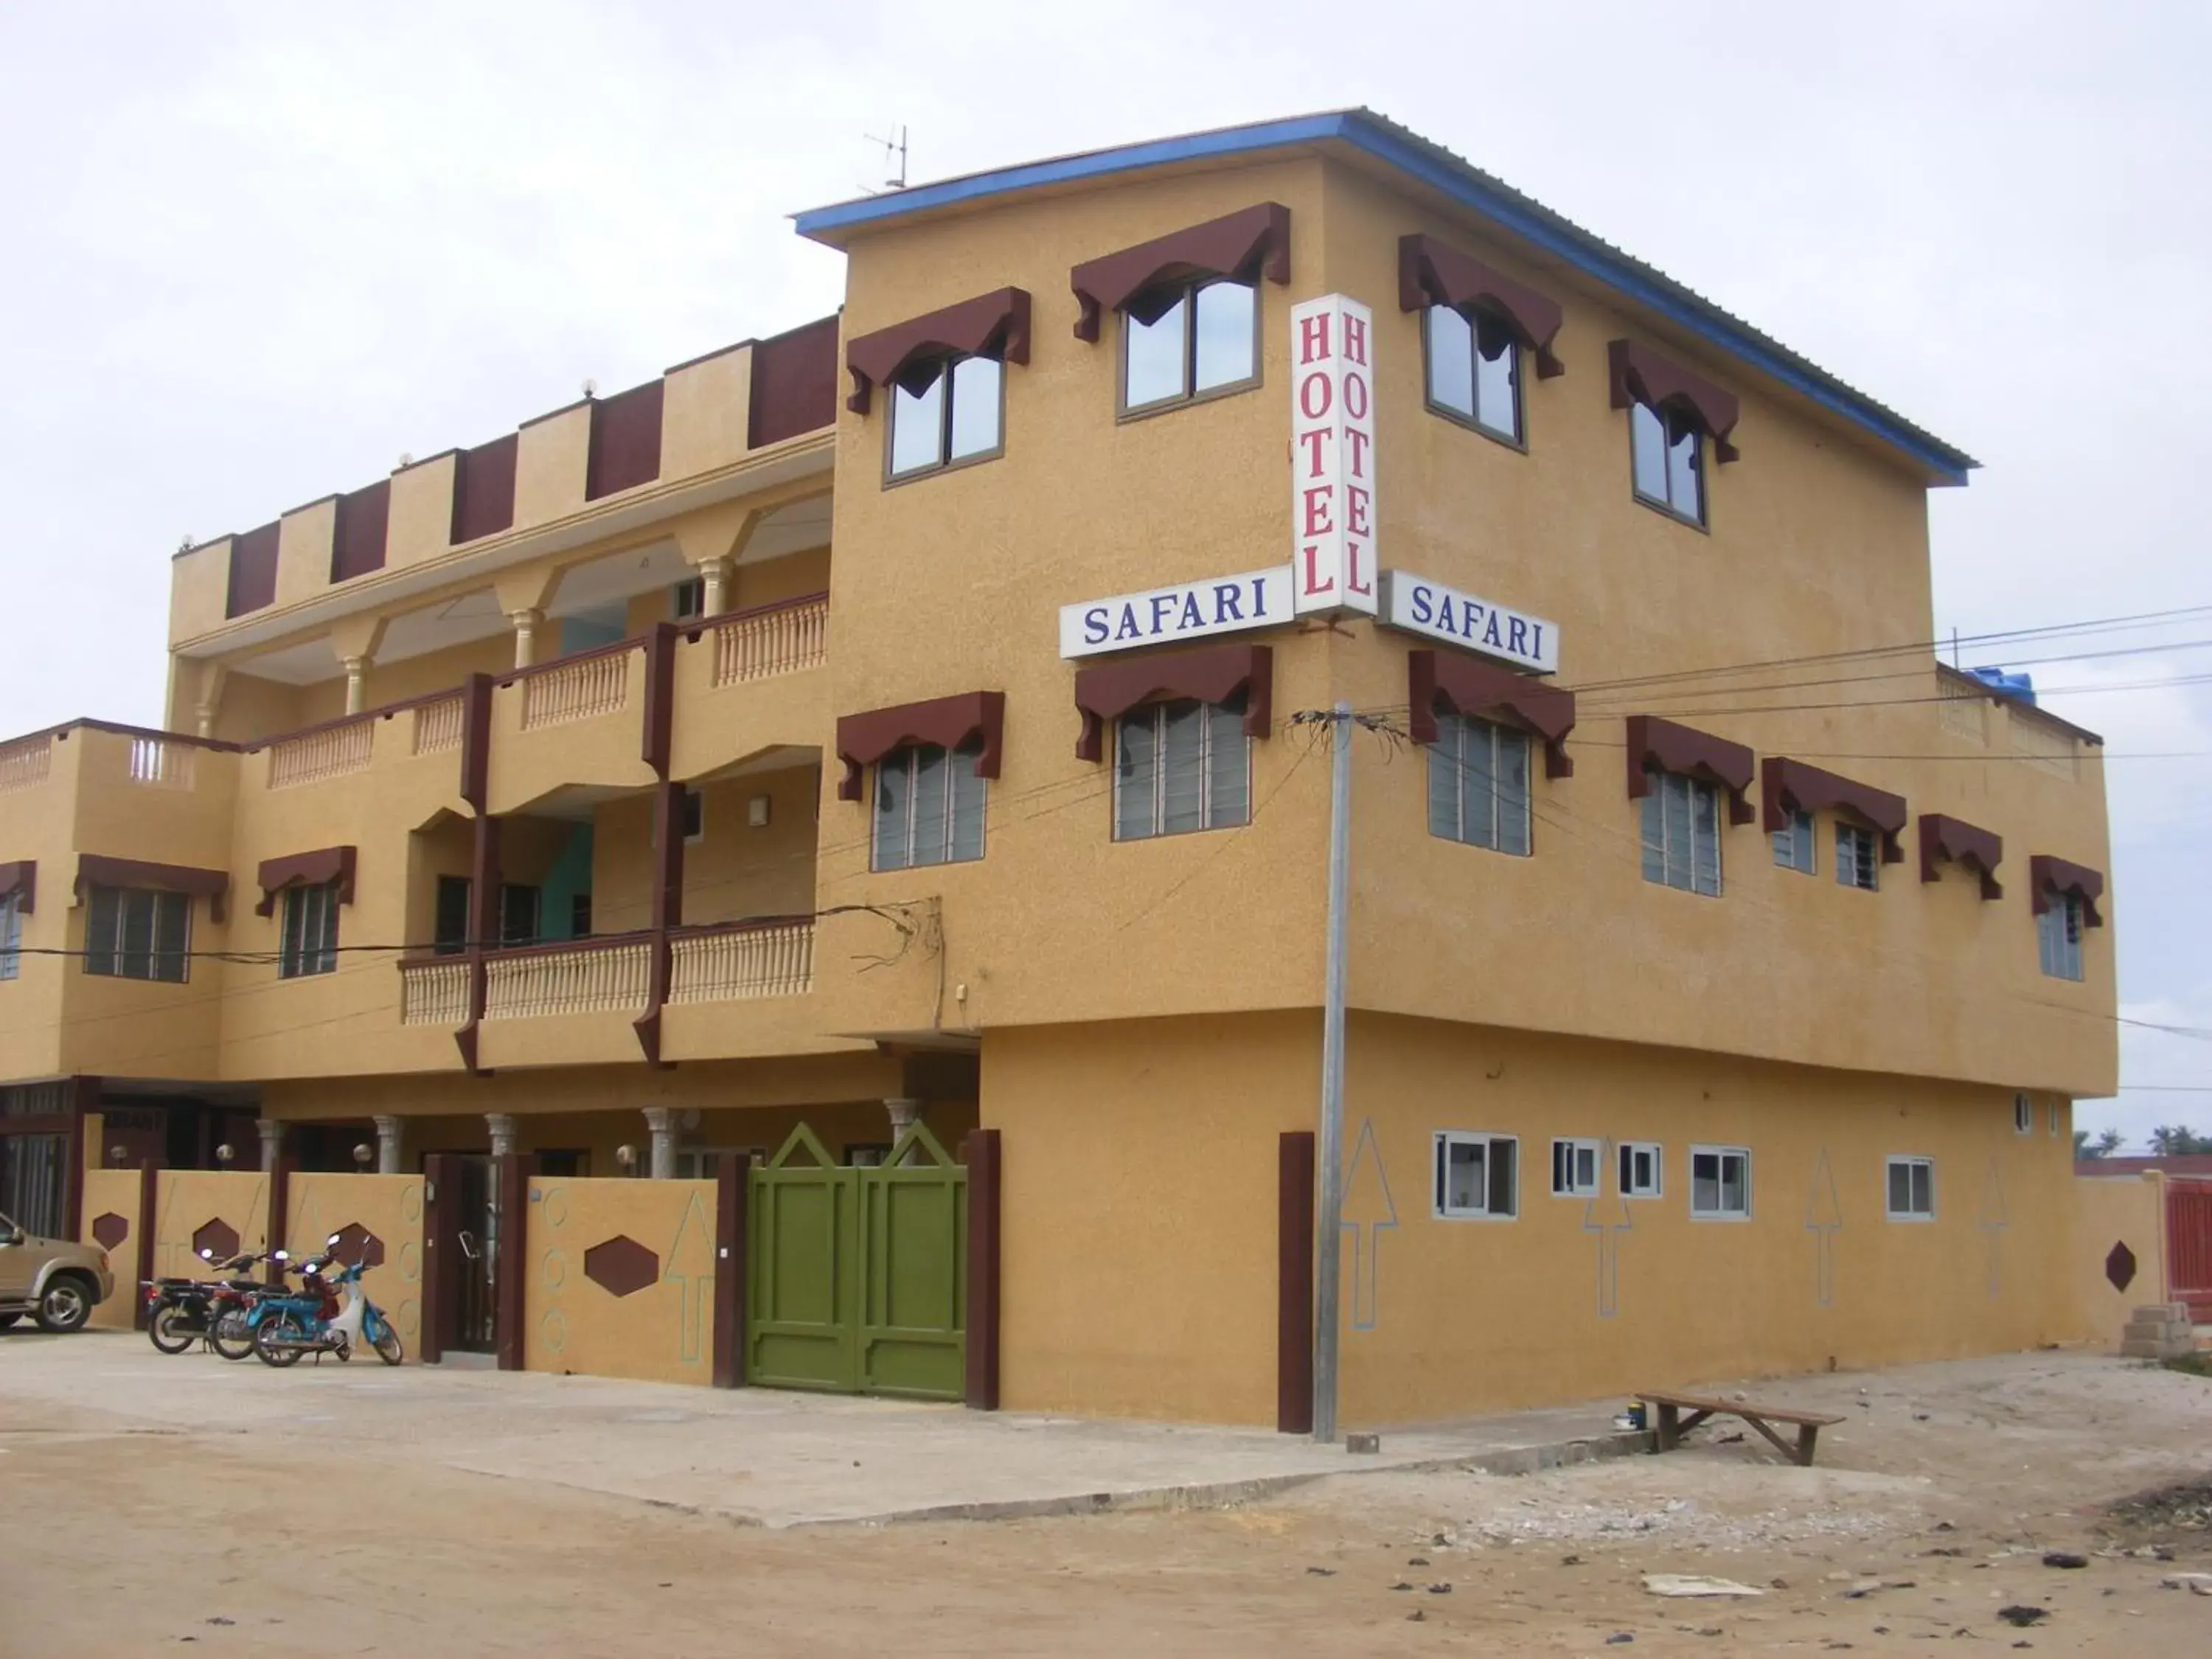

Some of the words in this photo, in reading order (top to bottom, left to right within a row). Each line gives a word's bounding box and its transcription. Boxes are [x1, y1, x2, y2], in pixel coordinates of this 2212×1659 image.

[1300, 312, 1332, 595] HOTEL
[1343, 312, 1370, 597] HOTEL
[1084, 578, 1267, 644] SAFARI
[1411, 586, 1543, 661] SAFARI
